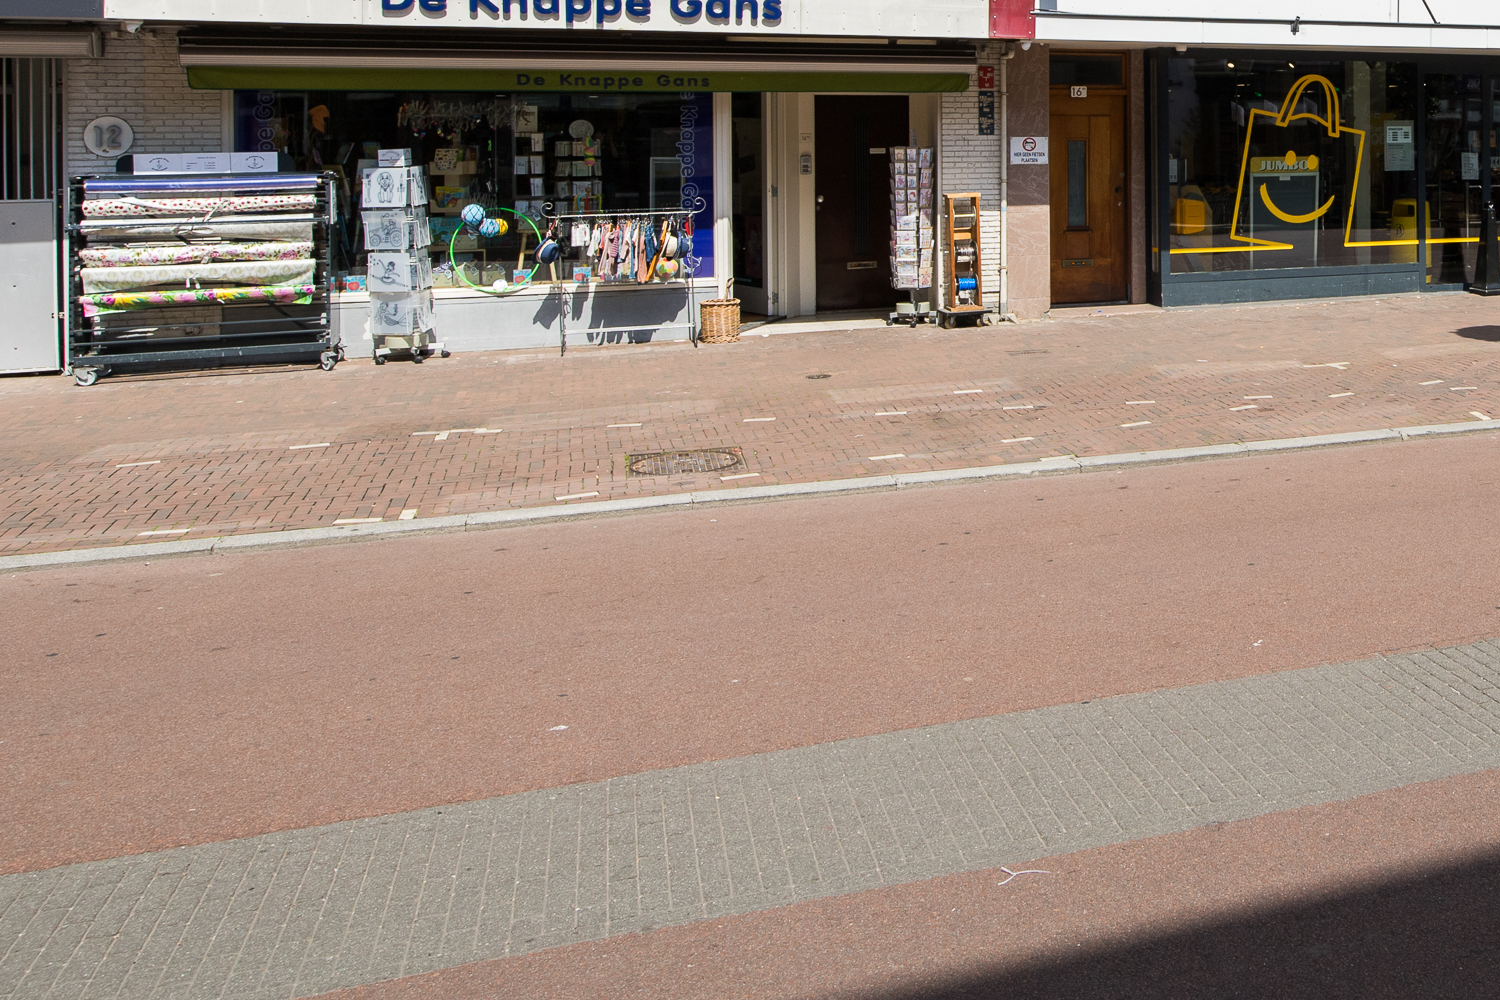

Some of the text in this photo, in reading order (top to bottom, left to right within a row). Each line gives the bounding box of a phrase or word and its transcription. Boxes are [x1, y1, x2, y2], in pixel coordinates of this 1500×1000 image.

[516, 74, 710, 90] De Knappe Gans
[93, 124, 122, 149] 12
[676, 105, 698, 178] Knappe
[1259, 160, 1309, 171] JUMBO
